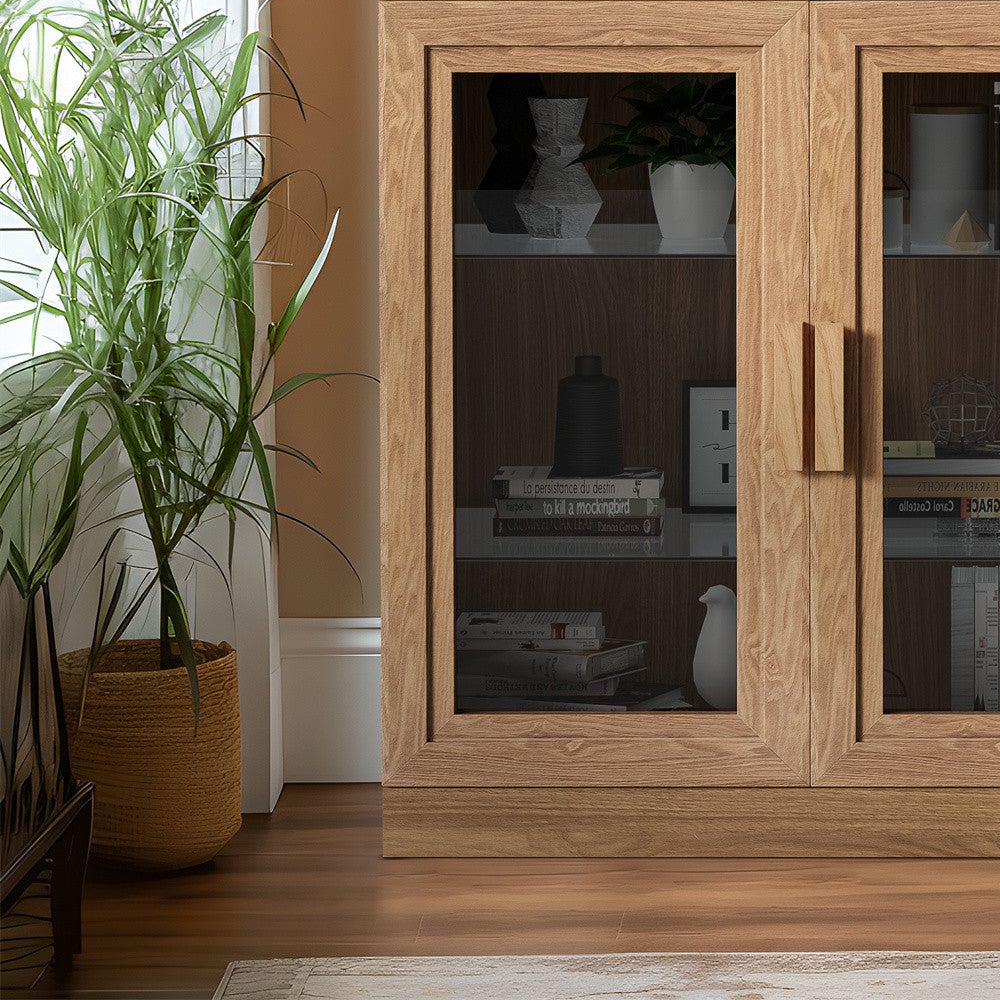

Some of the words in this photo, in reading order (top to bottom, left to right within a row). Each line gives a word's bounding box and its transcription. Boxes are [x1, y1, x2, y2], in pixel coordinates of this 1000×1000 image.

[524, 480, 532, 494] La
[534, 482, 578, 498] persistance
[580, 480, 590, 494] du
[592, 480, 616, 494] destin
[543, 502, 553, 515] to
[554, 500, 566, 514] kill
[568, 504, 574, 515] a
[576, 499, 630, 517] mockingbird
